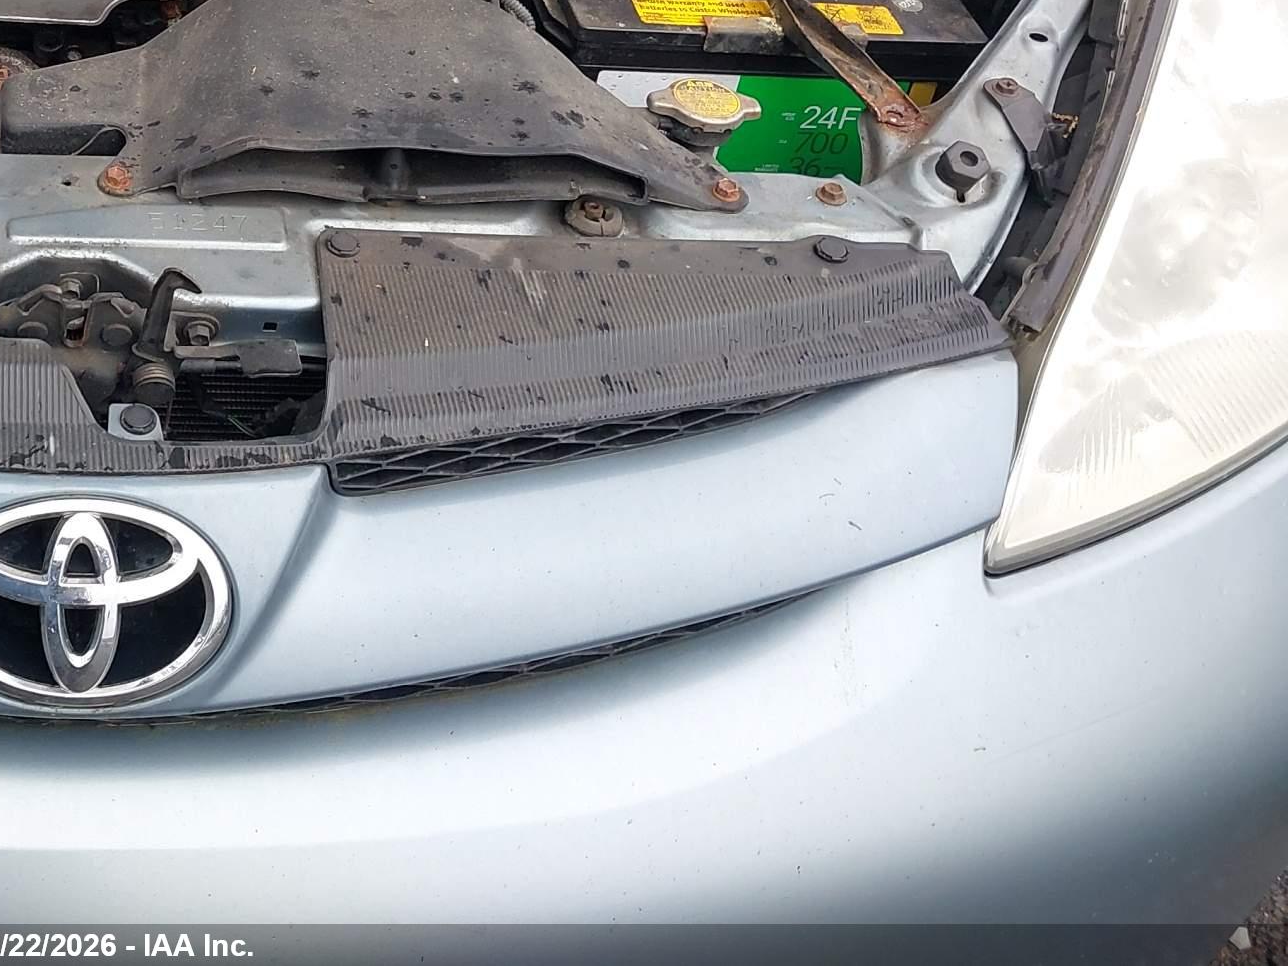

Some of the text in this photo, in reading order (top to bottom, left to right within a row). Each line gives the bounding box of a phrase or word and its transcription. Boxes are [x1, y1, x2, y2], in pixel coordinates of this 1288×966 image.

[667, 0, 705, 8] warranty
[799, 105, 862, 130] 24F
[795, 132, 849, 154] 700
